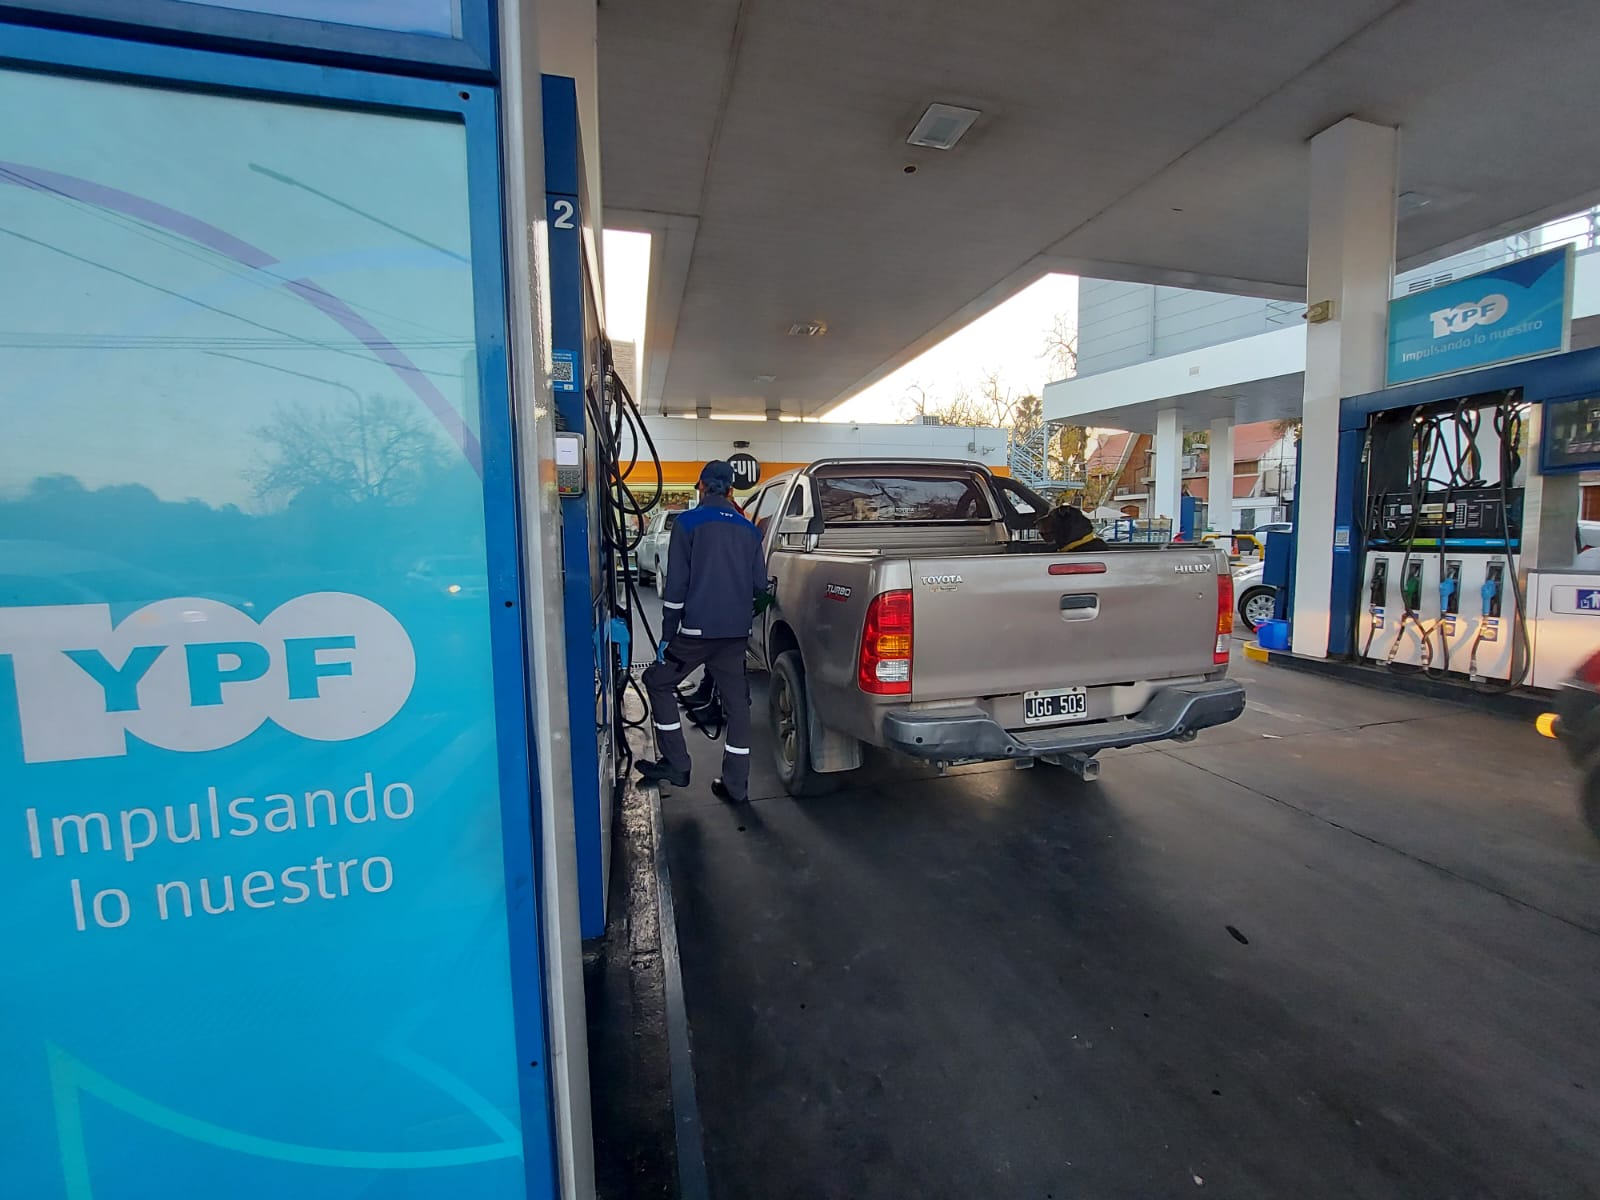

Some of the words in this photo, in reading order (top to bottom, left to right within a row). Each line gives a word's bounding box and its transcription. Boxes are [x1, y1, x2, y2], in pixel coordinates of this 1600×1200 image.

[553, 200, 574, 229] 2
[1441, 302, 1497, 328] YPF
[1402, 338, 1471, 363] Impulsando
[1474, 333, 1486, 345] lo
[1489, 320, 1544, 341] nuestro
[827, 584, 852, 597] TURBO
[920, 575, 964, 585] TOYOTA
[62, 635, 357, 713] YPF
[1027, 698, 1053, 718] JGG
[1060, 694, 1085, 714] 503
[26, 772, 415, 862] Impulsando
[70, 878, 131, 931] lo
[156, 854, 394, 921] nuestro
